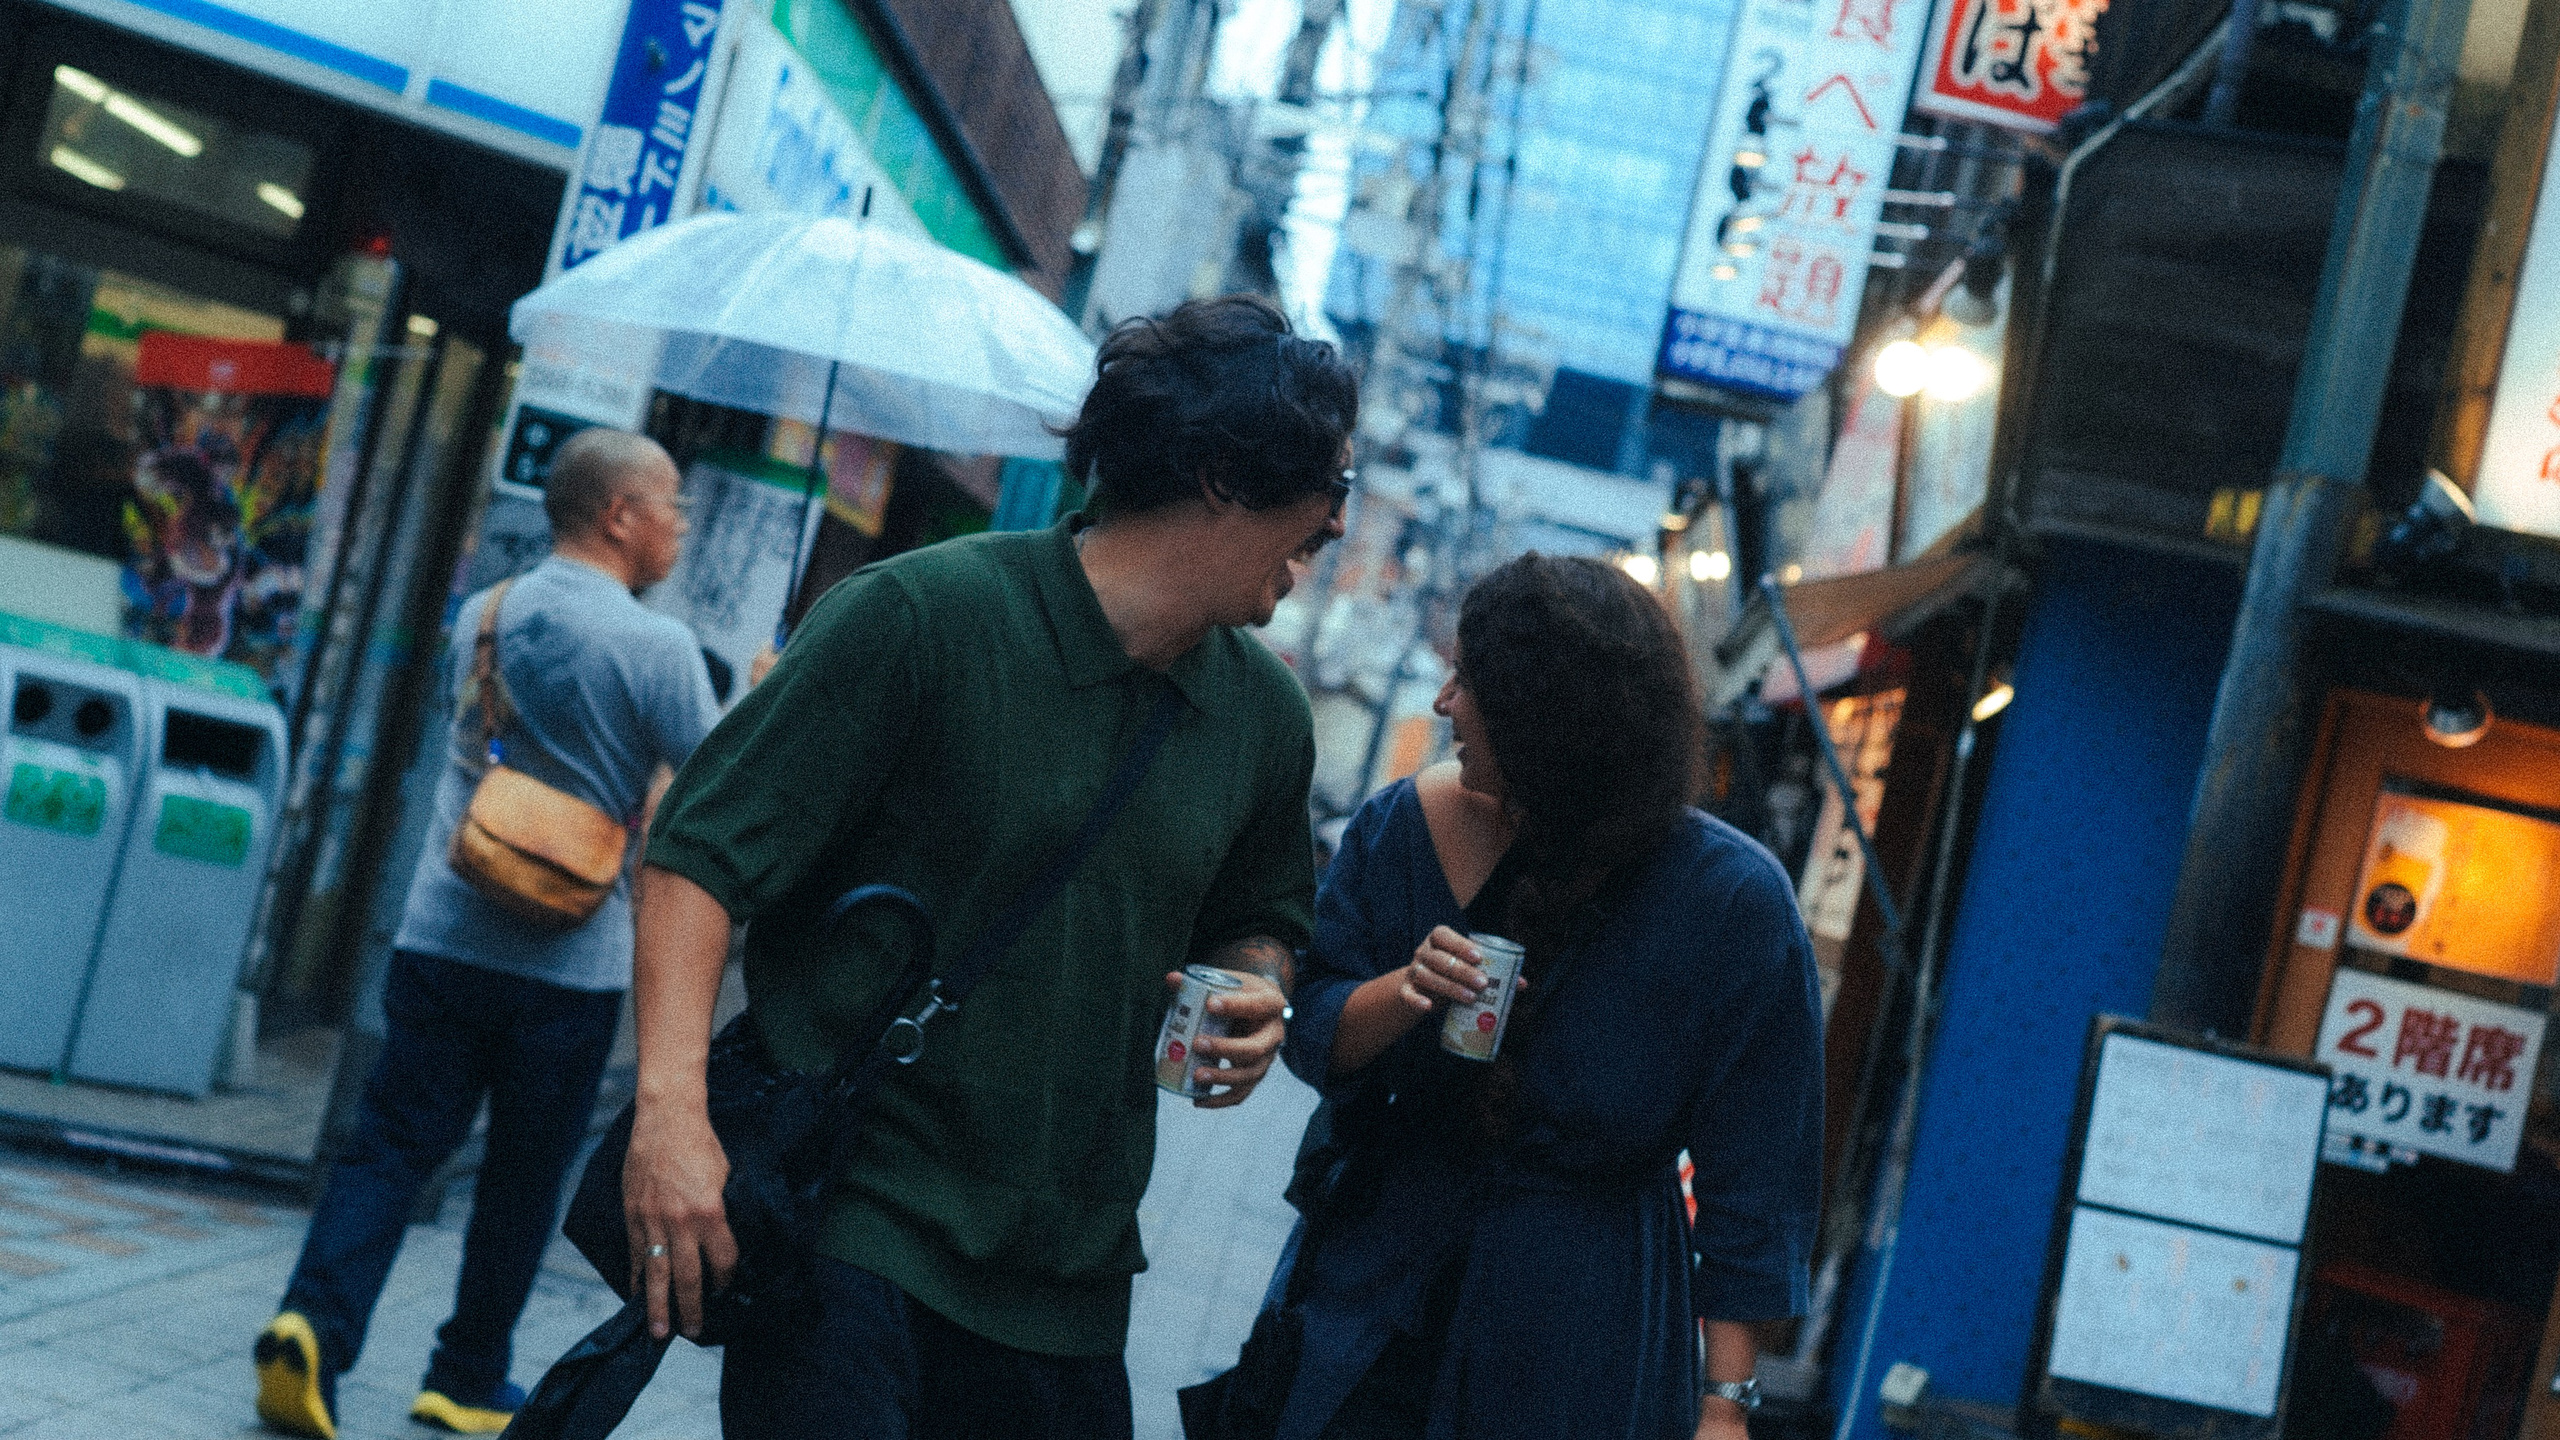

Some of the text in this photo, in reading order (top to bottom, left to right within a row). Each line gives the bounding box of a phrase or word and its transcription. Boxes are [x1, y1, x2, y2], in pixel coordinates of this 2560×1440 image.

[2336, 997, 2529, 1093] 2階席
[2328, 1071, 2506, 1146] あります
